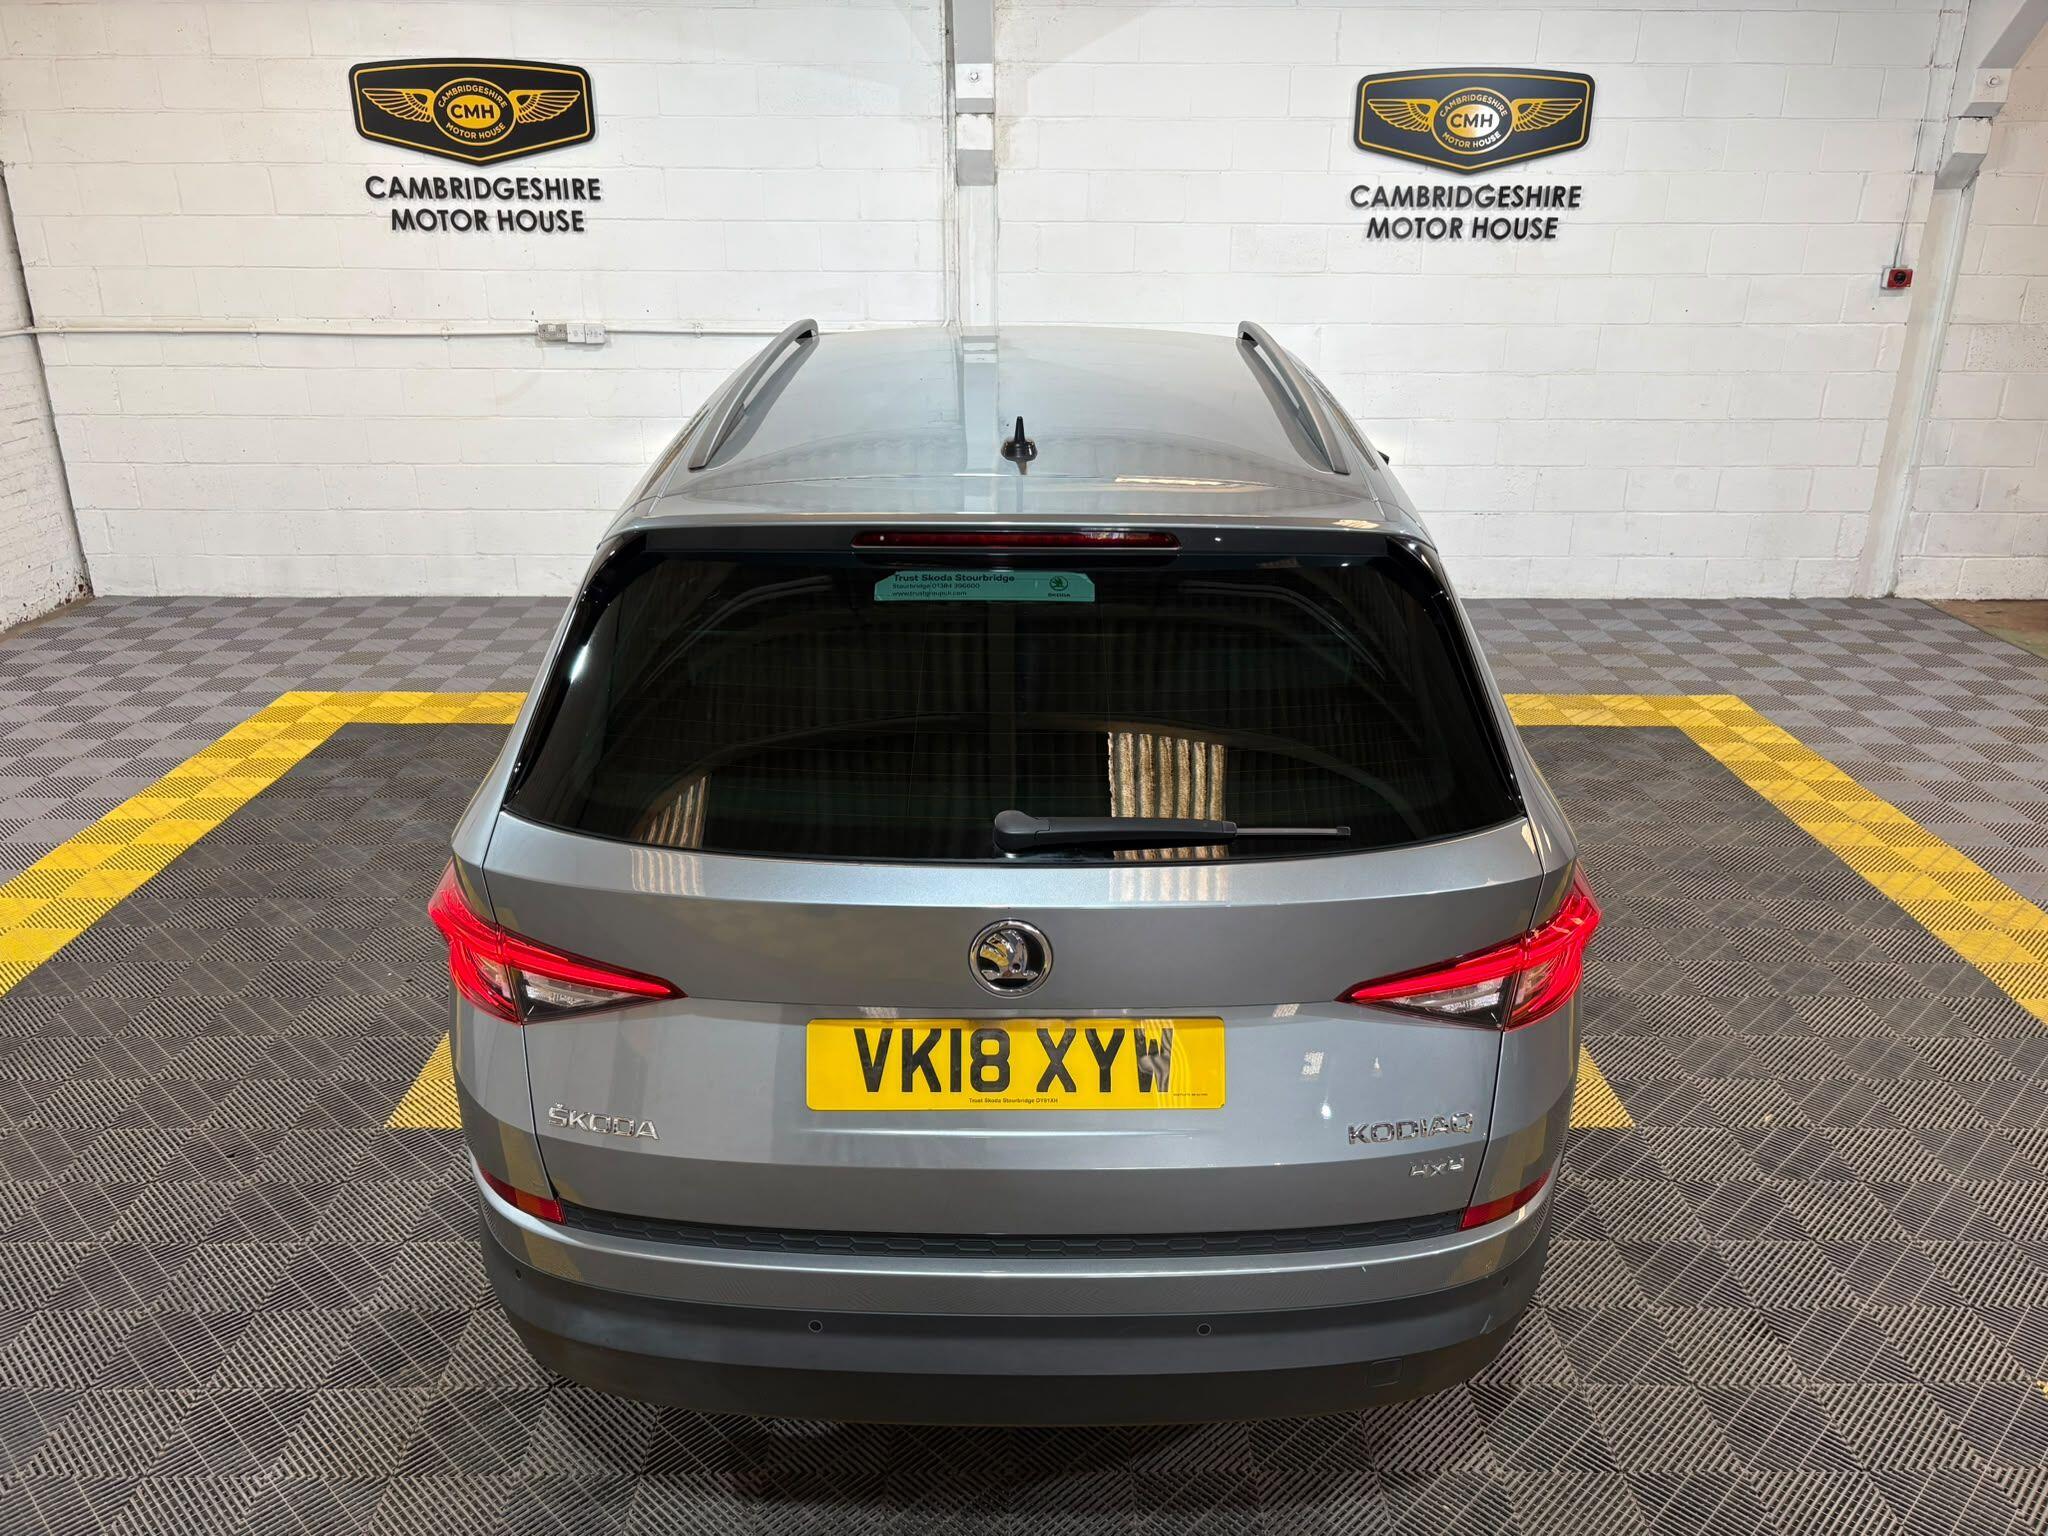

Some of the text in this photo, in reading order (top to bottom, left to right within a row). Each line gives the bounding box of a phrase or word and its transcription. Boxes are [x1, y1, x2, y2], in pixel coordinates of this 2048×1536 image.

[438, 84, 508, 108] CAMBRIDGESHIRE
[1439, 94, 1508, 117] CAMBRIDGESHIRE
[450, 104, 495, 119] CMH
[1450, 113, 1493, 128] CMH
[445, 122, 506, 139] MOTOR HOUSE
[1442, 131, 1501, 148] MOTOR HOUSE
[365, 175, 602, 201] CAMBRIDGESHIRE
[1349, 184, 1582, 209] CAMBRIDGESHIRE
[391, 208, 585, 233] MOTOR HOUSE
[1366, 217, 1559, 240] MOTOR HOUSE
[892, 582, 931, 591] Stourbridge
[894, 573, 1015, 584] Trust Skoda Stourbridge
[854, 1028, 1174, 1092] VK18 XYW
[1002, 1097, 1035, 1105] Stourbridge
[548, 1102, 660, 1141] ŠKODA
[1347, 1111, 1474, 1145] KODIAQ
